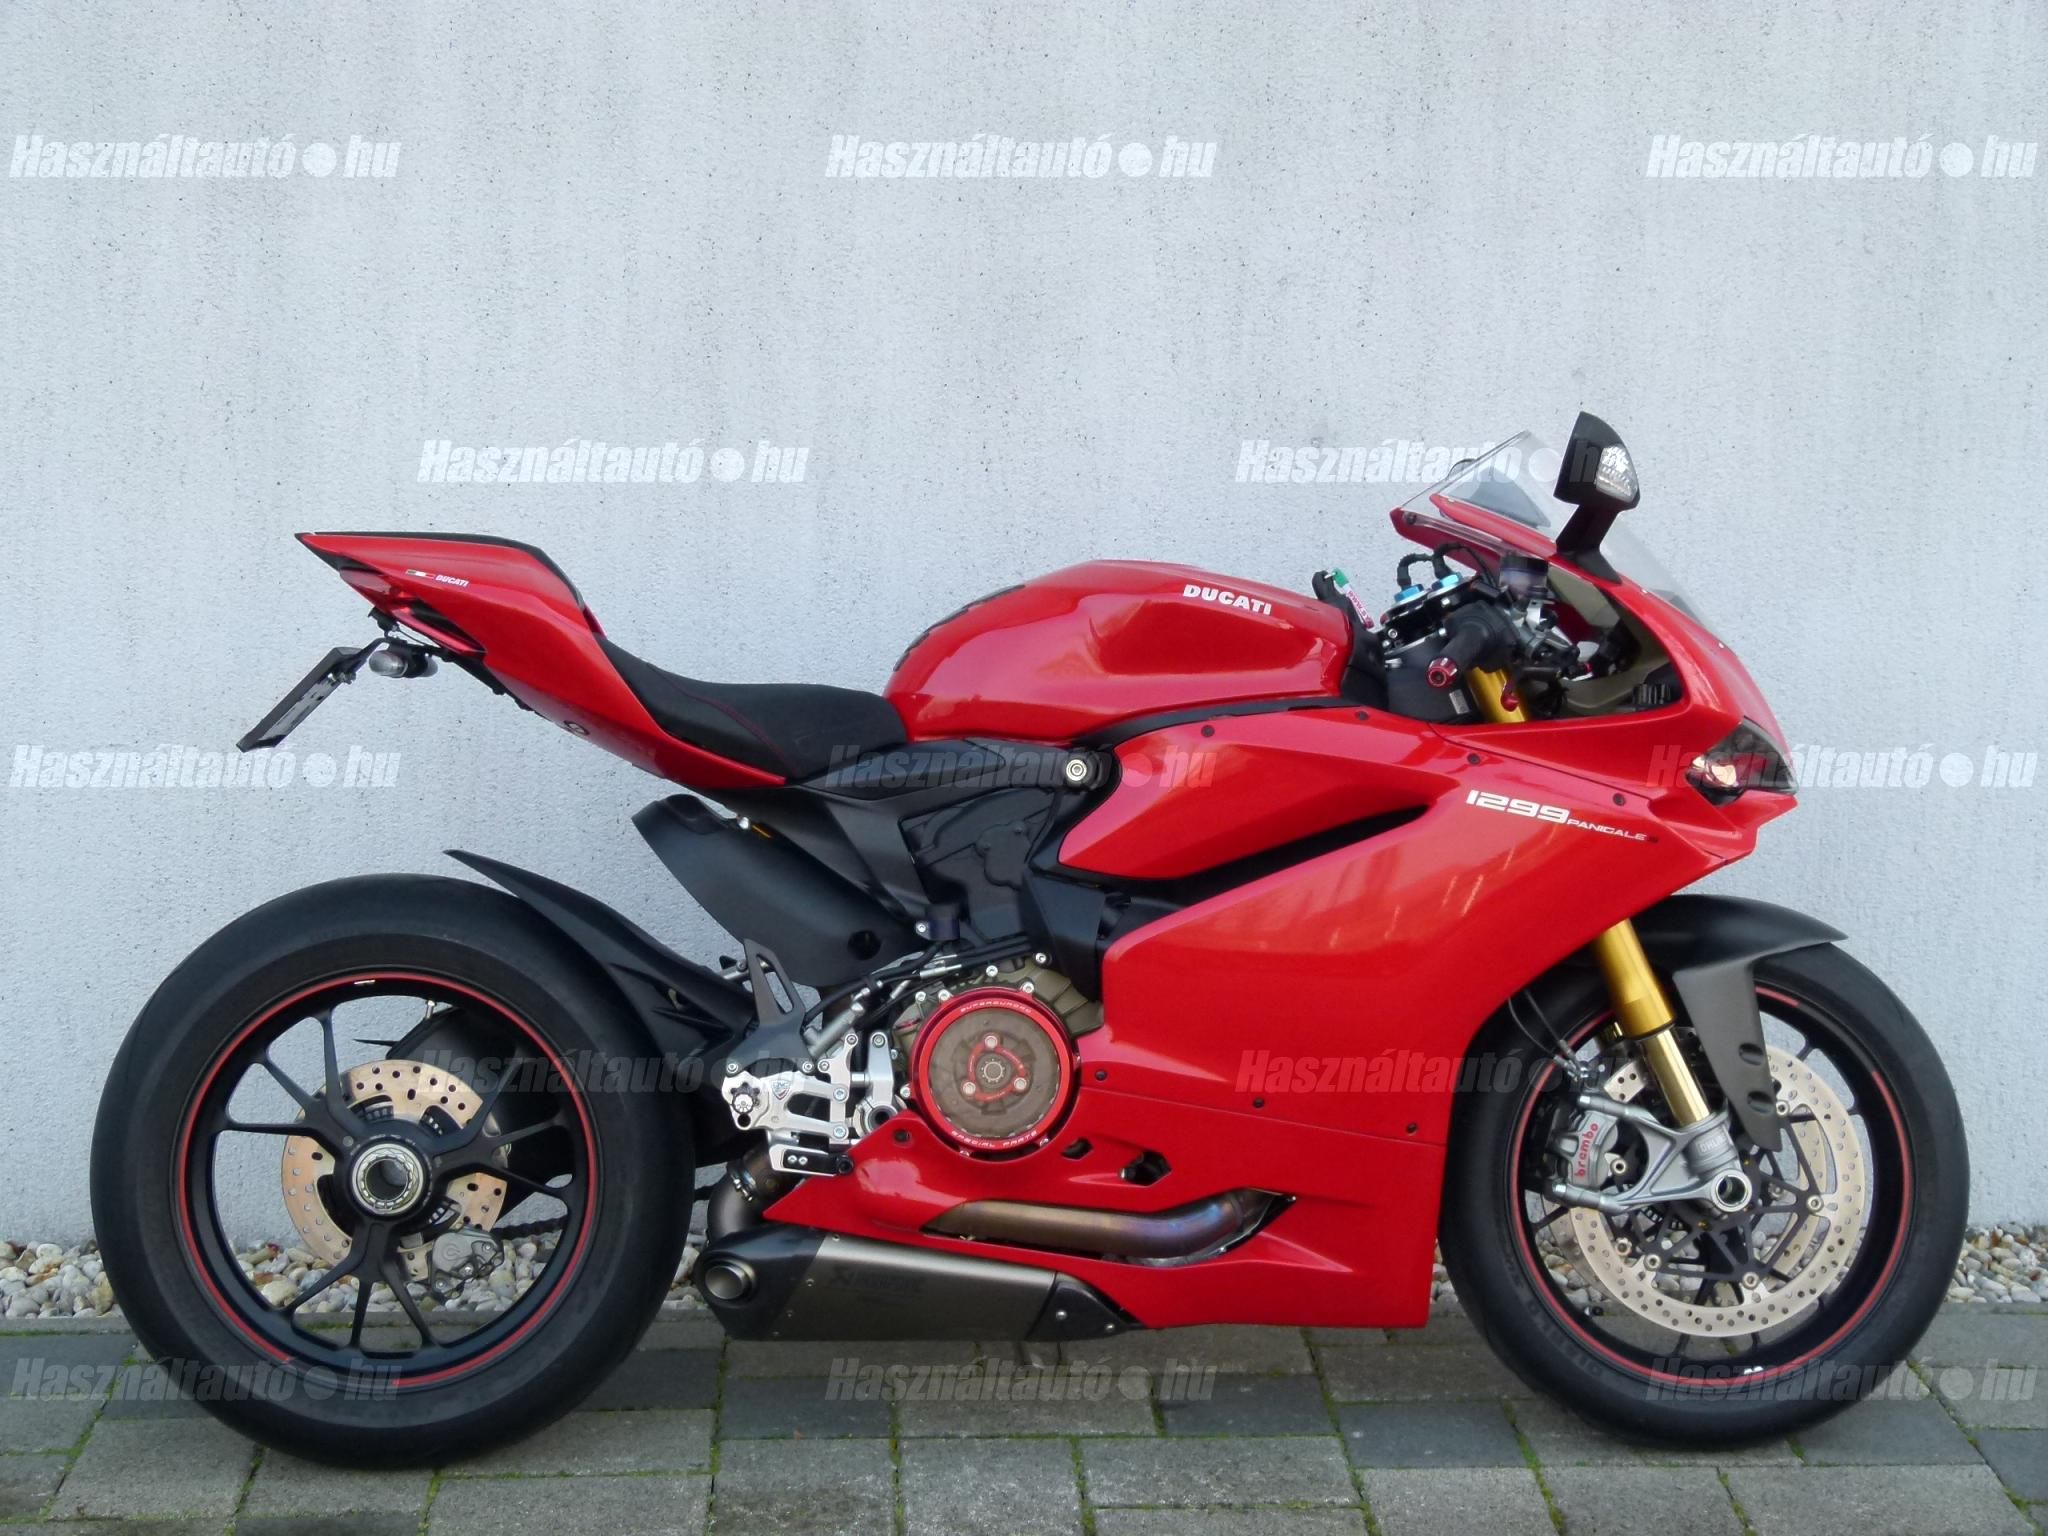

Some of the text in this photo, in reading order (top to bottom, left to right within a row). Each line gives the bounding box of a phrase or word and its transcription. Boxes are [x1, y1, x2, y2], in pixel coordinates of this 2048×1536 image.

[435, 574, 469, 587] DUCATI
[1183, 584, 1272, 615] DUCATI
[1466, 789, 1647, 841] 1299 PANIGALE
[1575, 1123, 1599, 1177] brembo
